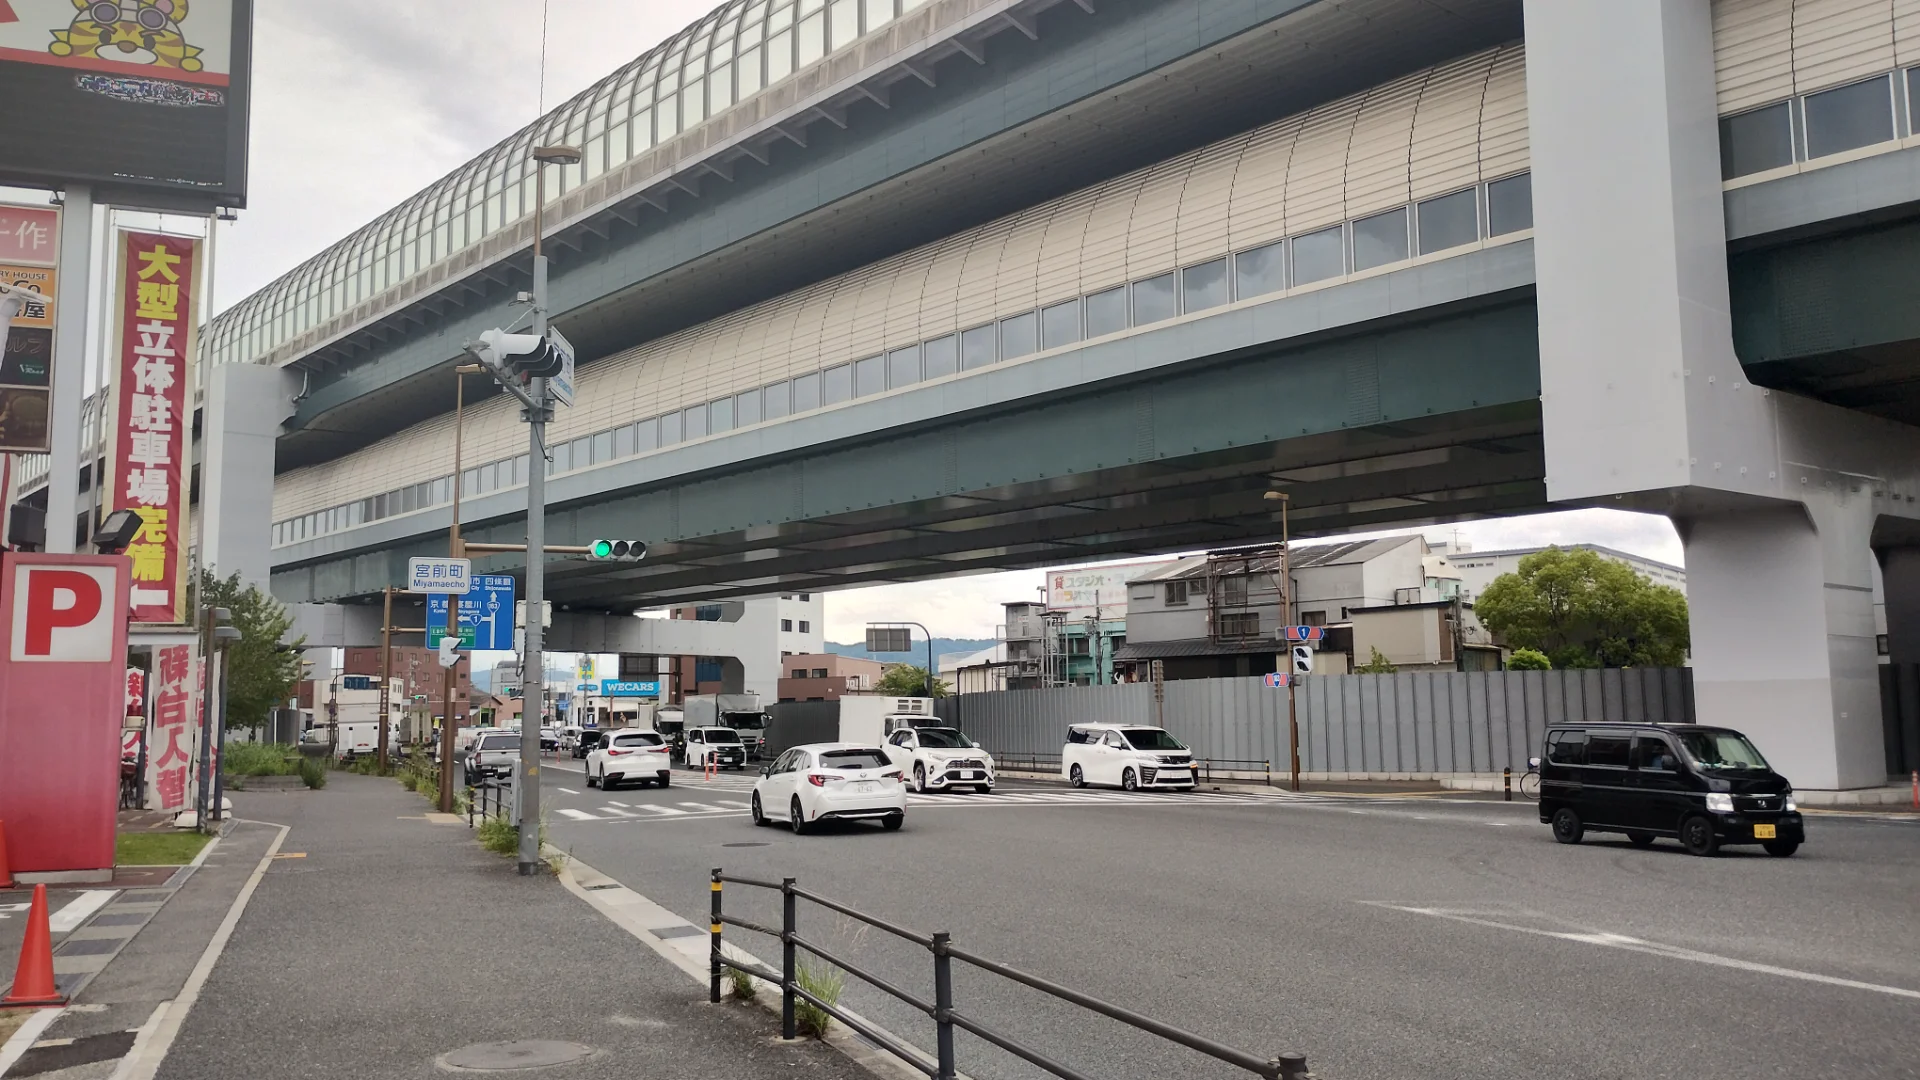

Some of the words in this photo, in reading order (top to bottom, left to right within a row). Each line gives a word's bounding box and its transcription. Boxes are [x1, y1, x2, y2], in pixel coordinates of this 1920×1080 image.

[13, 271, 47, 280] HOUSE
[125, 245, 181, 582] 大型立体駐車場完備
[415, 564, 464, 578] 宮前町
[413, 580, 466, 589] Miyamaecho
[24, 570, 103, 656] P
[1301, 628, 1306, 637] 1
[606, 683, 654, 691] WECARS
